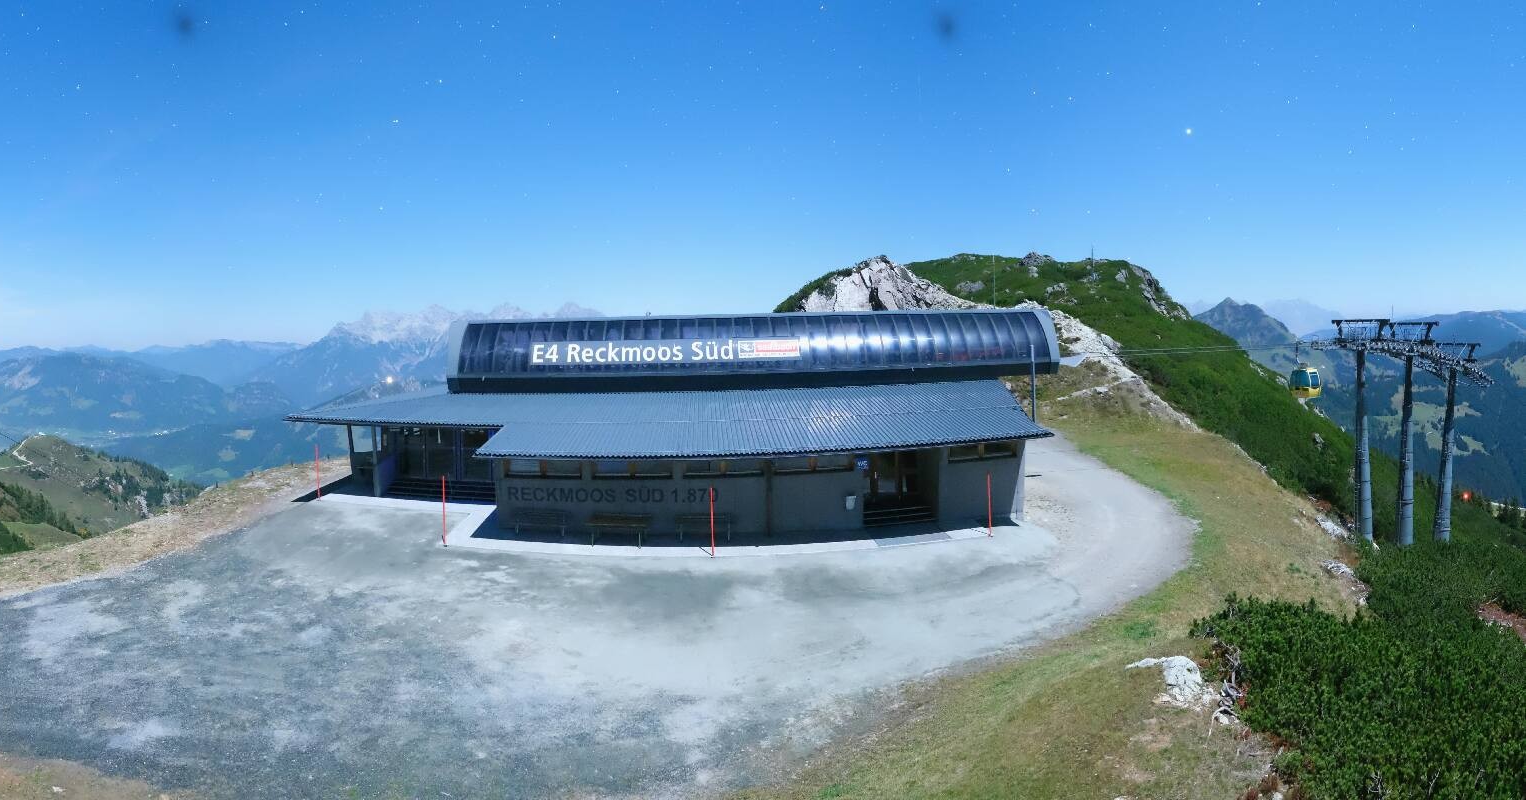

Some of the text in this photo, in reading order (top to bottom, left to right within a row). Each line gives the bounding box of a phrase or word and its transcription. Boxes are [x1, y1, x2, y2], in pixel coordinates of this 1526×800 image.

[532, 344, 558, 363] E4
[566, 342, 683, 362] Reckmoos
[691, 340, 734, 361] Süd
[507, 486, 616, 502] RECKMOOS
[625, 486, 664, 503] SÜD
